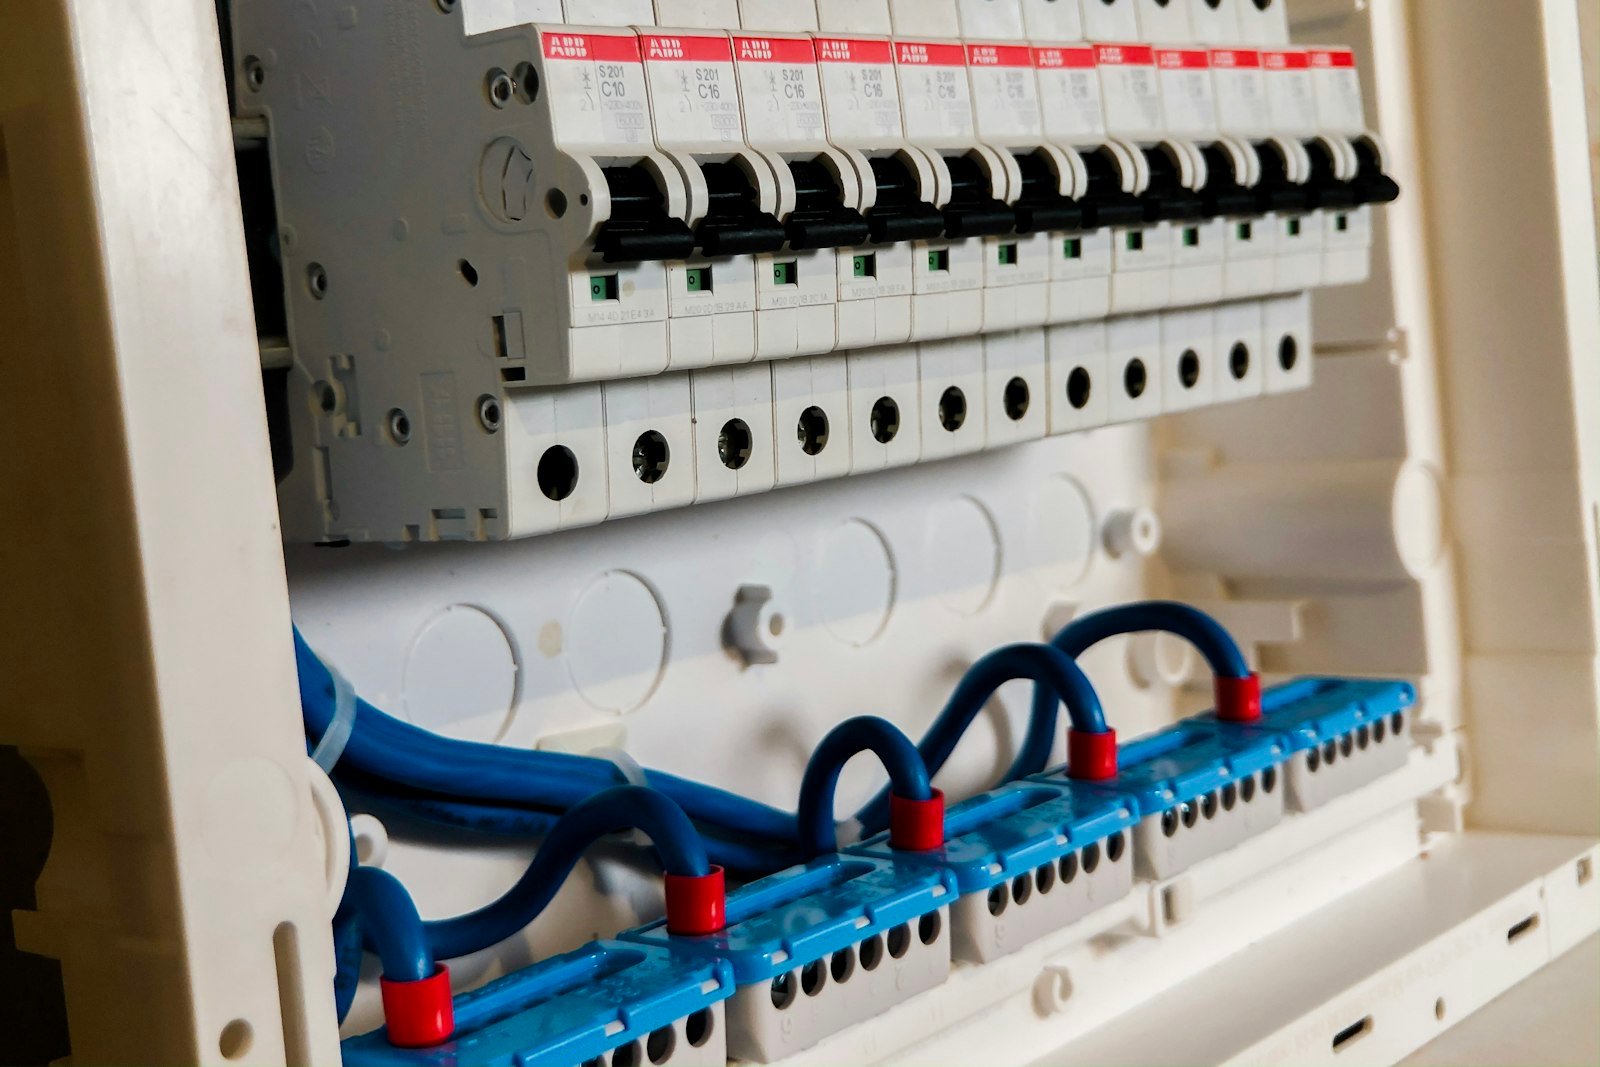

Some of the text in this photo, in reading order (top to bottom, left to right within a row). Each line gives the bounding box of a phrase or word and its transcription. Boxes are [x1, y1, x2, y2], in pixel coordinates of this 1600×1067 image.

[549, 36, 588, 57] ABB
[649, 38, 684, 58] ABB
[741, 40, 772, 59] ABB
[822, 41, 850, 60] ABB
[901, 45, 928, 63] ABB
[601, 81, 625, 97] C10
[698, 84, 720, 99] C16
[784, 84, 805, 99] C16
[863, 83, 883, 98] C16
